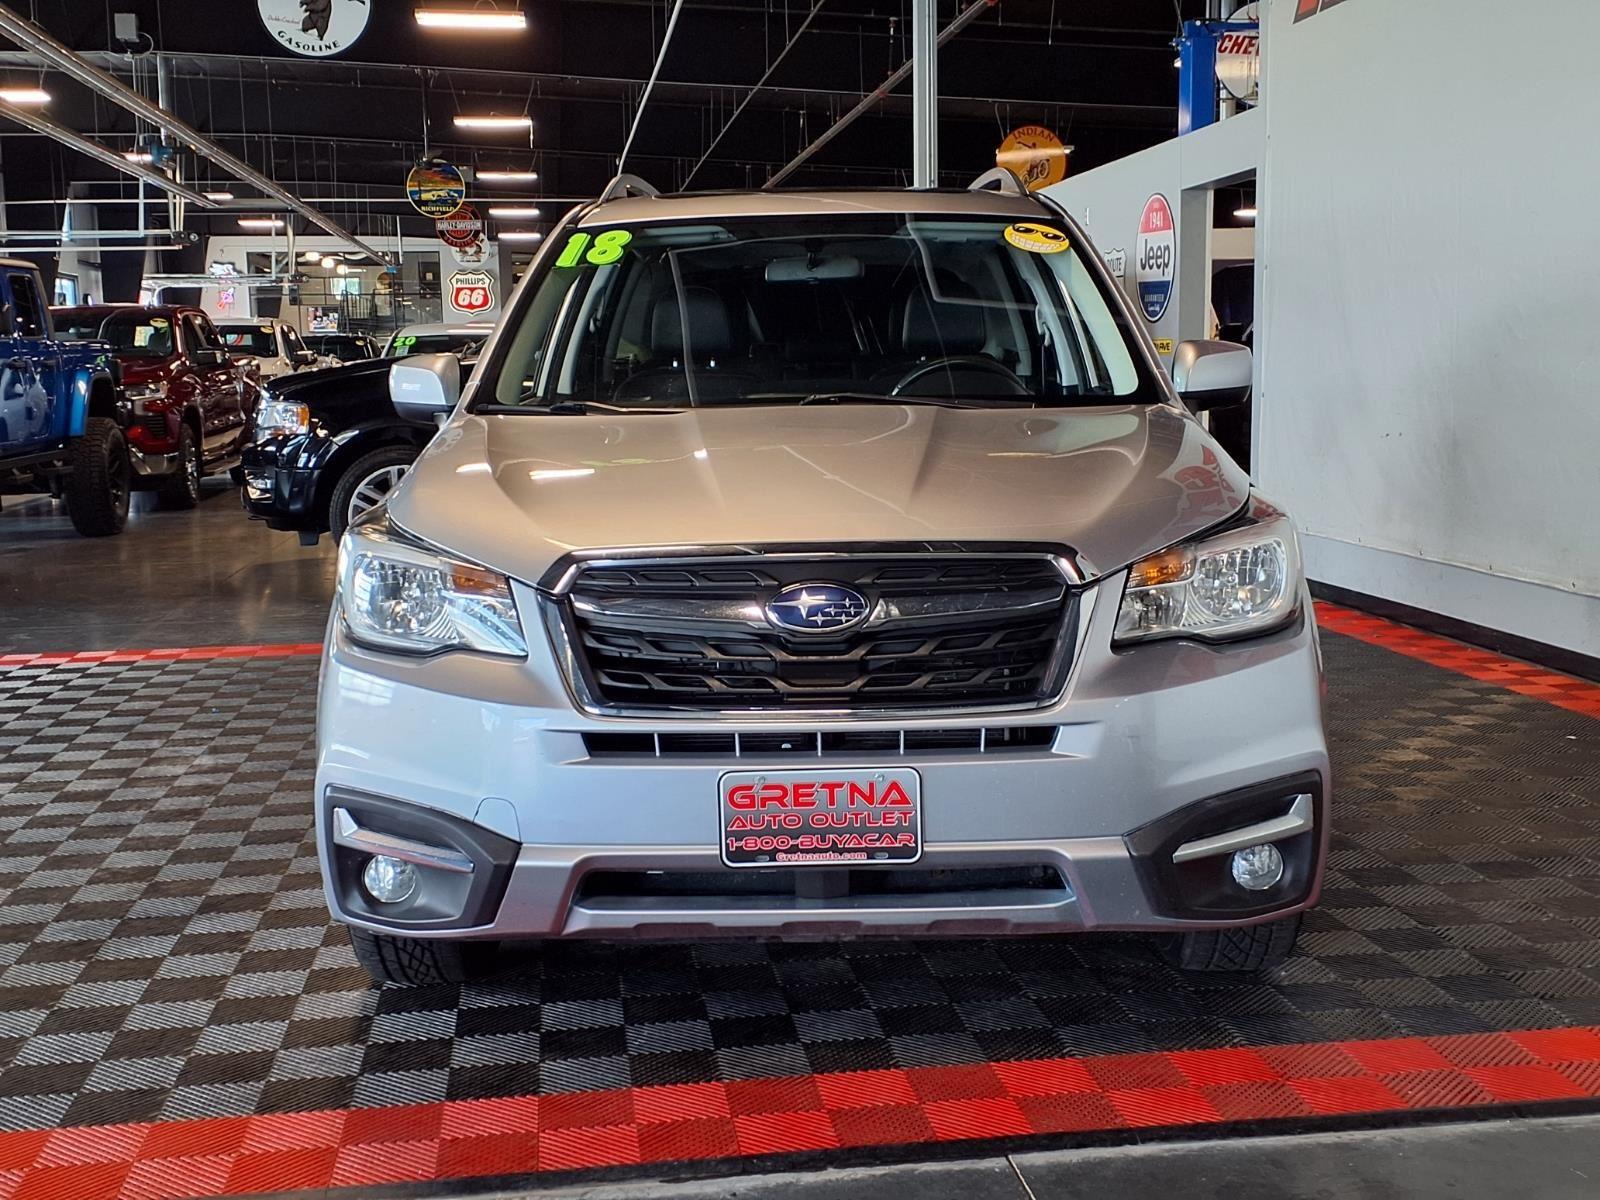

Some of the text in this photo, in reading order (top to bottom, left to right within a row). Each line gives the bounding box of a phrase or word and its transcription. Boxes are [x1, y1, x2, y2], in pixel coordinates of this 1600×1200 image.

[277, 30, 341, 52] GASOLINE
[1012, 127, 1055, 142] INDIAN
[1149, 211, 1164, 229] 1941
[555, 230, 633, 267] 18
[1140, 238, 1171, 277] Jeep
[455, 277, 486, 286] PHILLIPS
[457, 289, 485, 306] 66
[393, 336, 416, 347] 20
[727, 780, 913, 810] GRETNA
[727, 811, 915, 831] AUTO OUTLET
[727, 833, 915, 851] 1-800-BUYACAR
[776, 851, 867, 861] Gretnaauto.com
